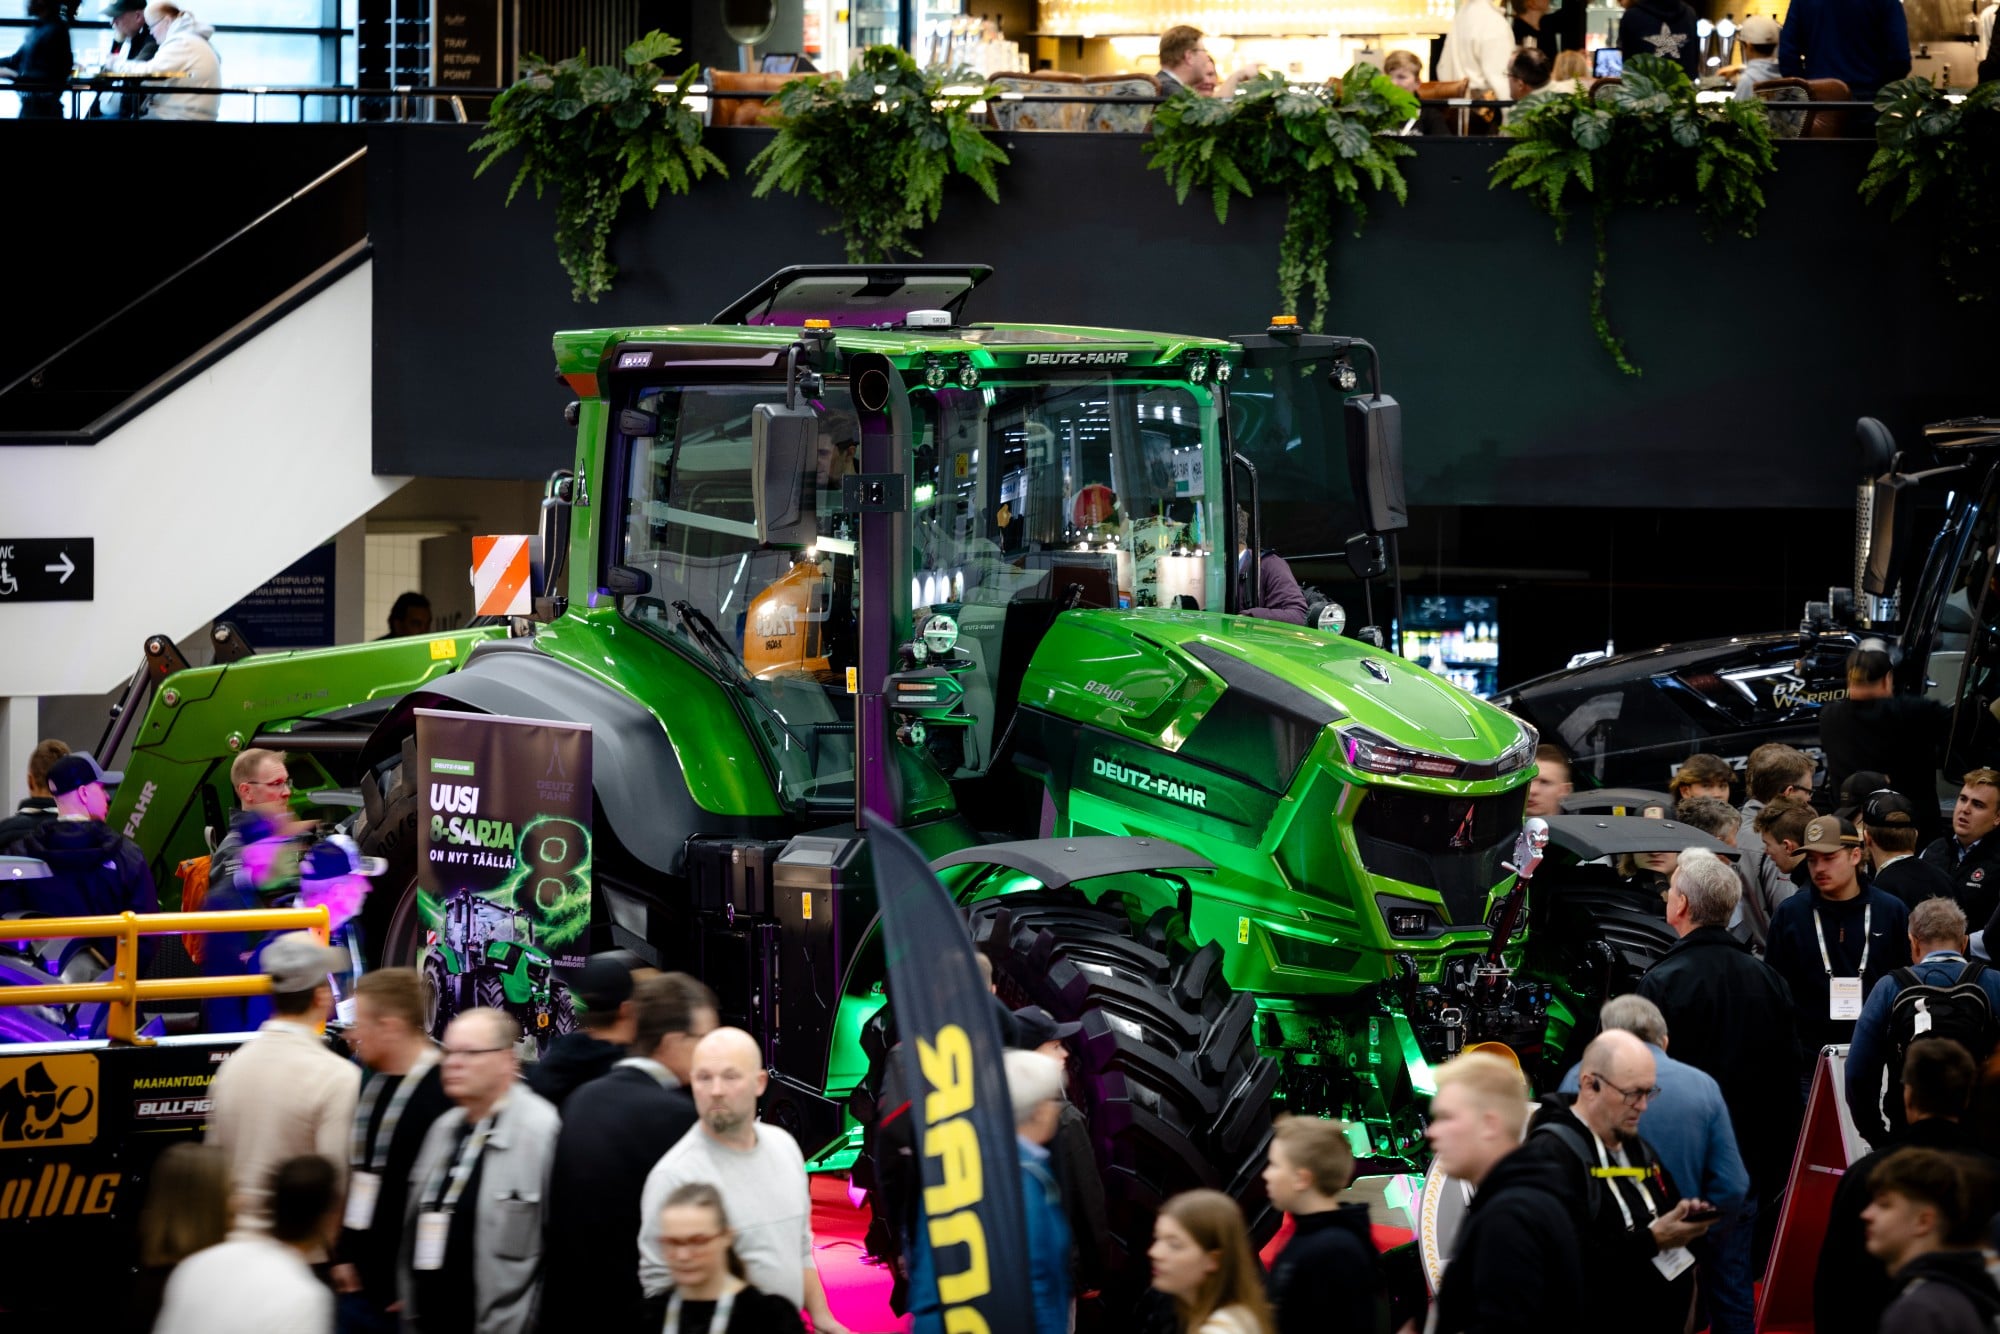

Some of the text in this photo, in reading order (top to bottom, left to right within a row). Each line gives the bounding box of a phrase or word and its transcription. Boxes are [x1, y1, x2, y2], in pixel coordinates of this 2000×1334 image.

[444, 38, 467, 48] TRAY
[443, 54, 480, 64] RETURN
[443, 70, 471, 80] POINT
[1025, 352, 1129, 365] DEUTZ-FAHR
[0, 545, 15, 559] WC
[312, 576, 325, 584] ON
[293, 587, 325, 595] VALINTA
[1083, 680, 1124, 701] 8340
[434, 762, 471, 772] DEUTZ-FAHR
[536, 780, 575, 792] DEUTZ
[1092, 758, 1206, 808] DEUTZ-FAHR
[430, 783, 480, 814] UUSI
[539, 791, 571, 802] FAHR
[123, 780, 158, 839] FAHR
[430, 815, 516, 850] 8-SARJA
[429, 850, 517, 870] ON NYT TÄÄLLÄ!
[554, 960, 586, 968] WARRIORS
